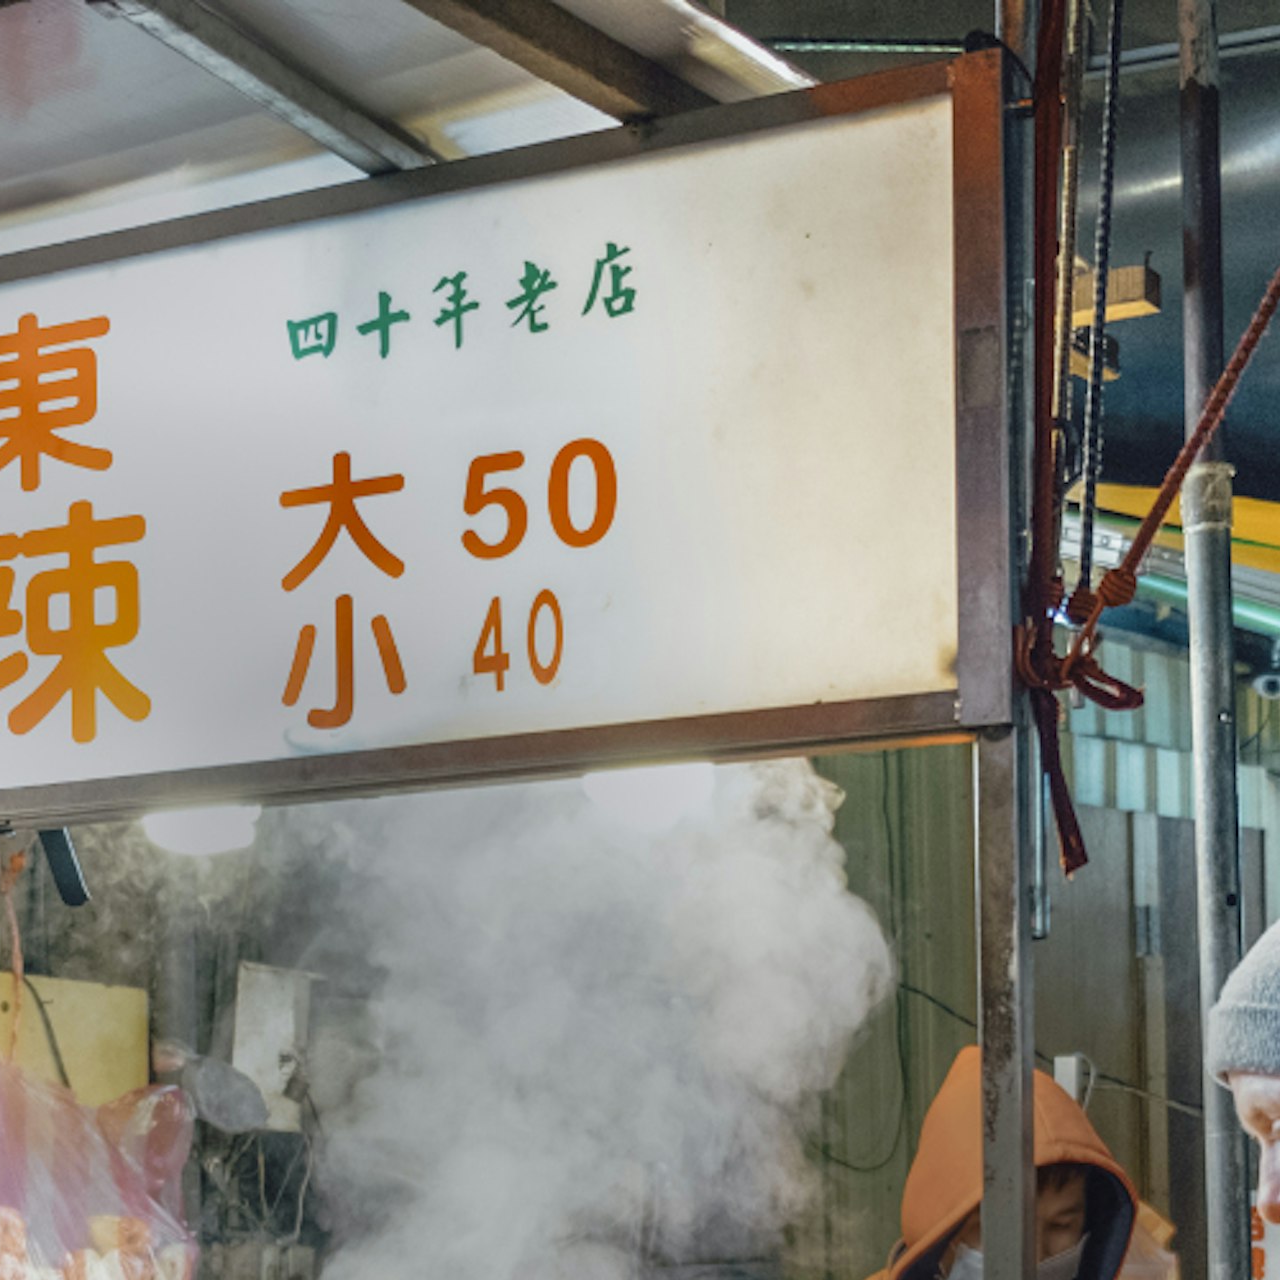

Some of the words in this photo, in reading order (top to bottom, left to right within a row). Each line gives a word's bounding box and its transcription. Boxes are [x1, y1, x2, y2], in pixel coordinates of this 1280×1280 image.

[286, 242, 638, 359] 四十年老店
[279, 451, 405, 591] 大
[461, 438, 617, 560] 50
[281, 594, 407, 729] 小
[473, 589, 564, 692] 40
